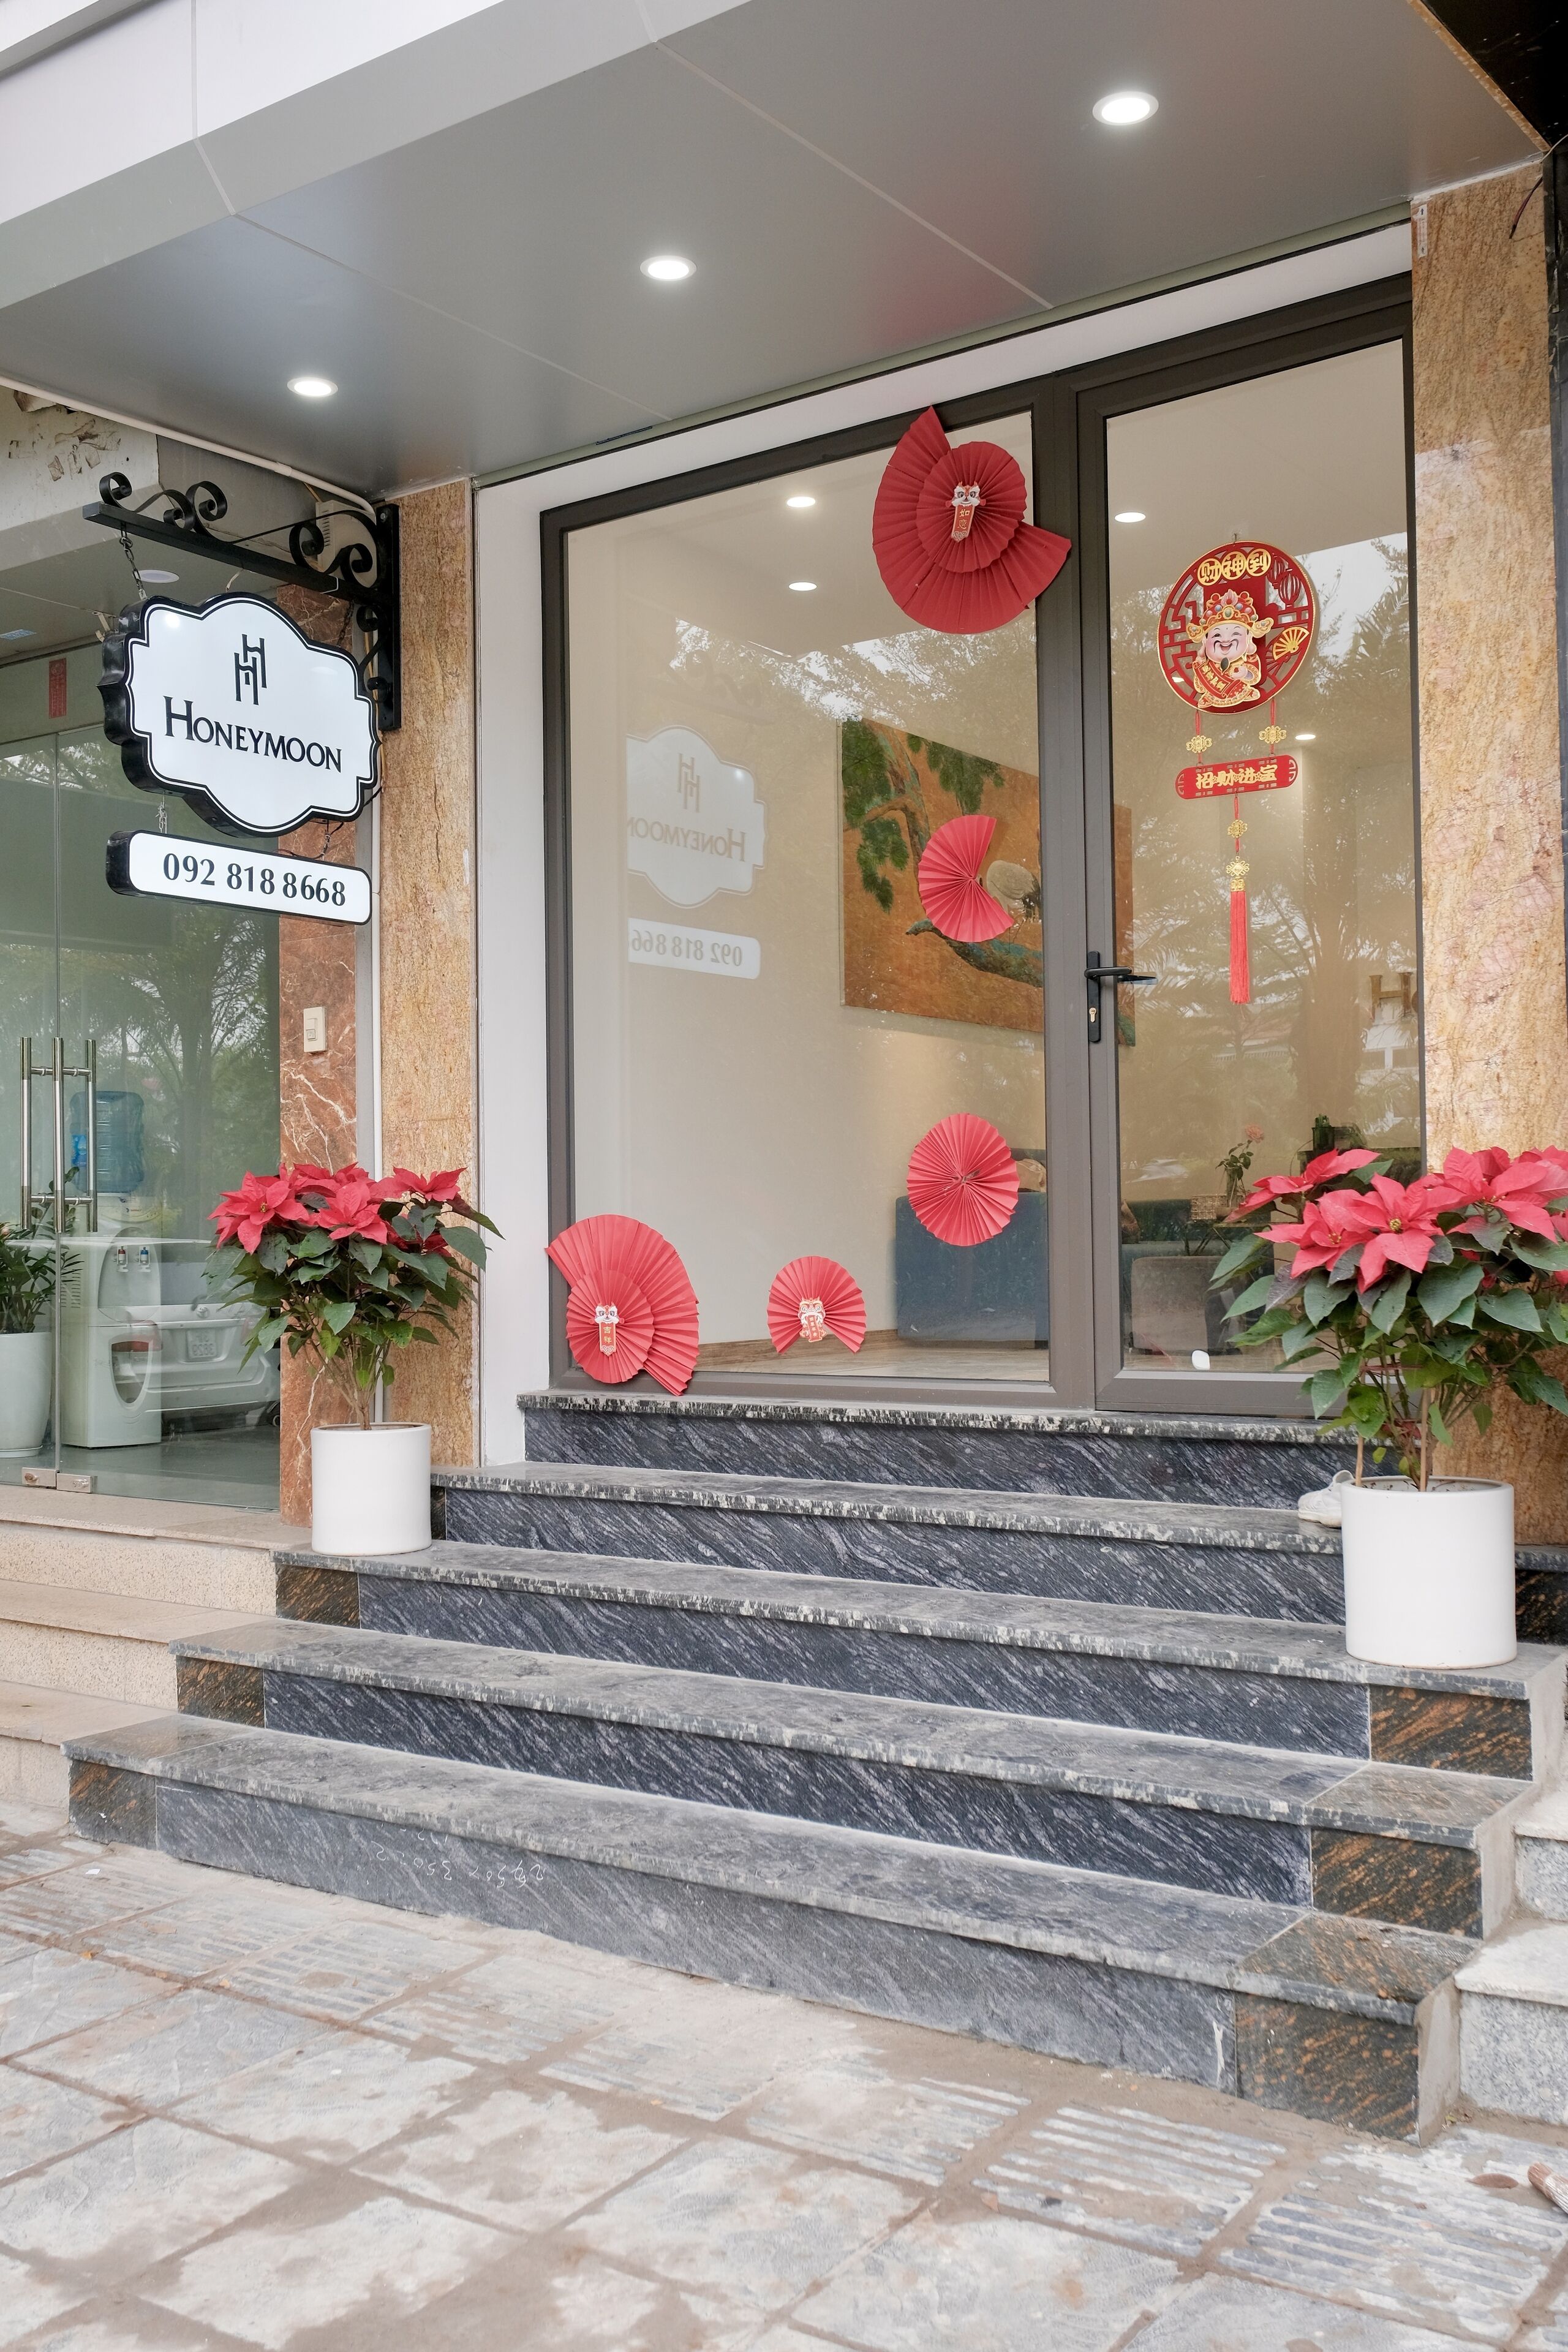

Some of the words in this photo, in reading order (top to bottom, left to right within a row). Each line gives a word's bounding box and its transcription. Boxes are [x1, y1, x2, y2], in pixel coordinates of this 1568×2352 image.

[1200, 551, 1268, 583] 财神到
[1195, 764, 1278, 790] 招财进宝
[163, 853, 215, 886] 092
[227, 862, 275, 895] 818
[282, 872, 346, 907] 8668
[603, 1325, 612, 1344] 吉祥
